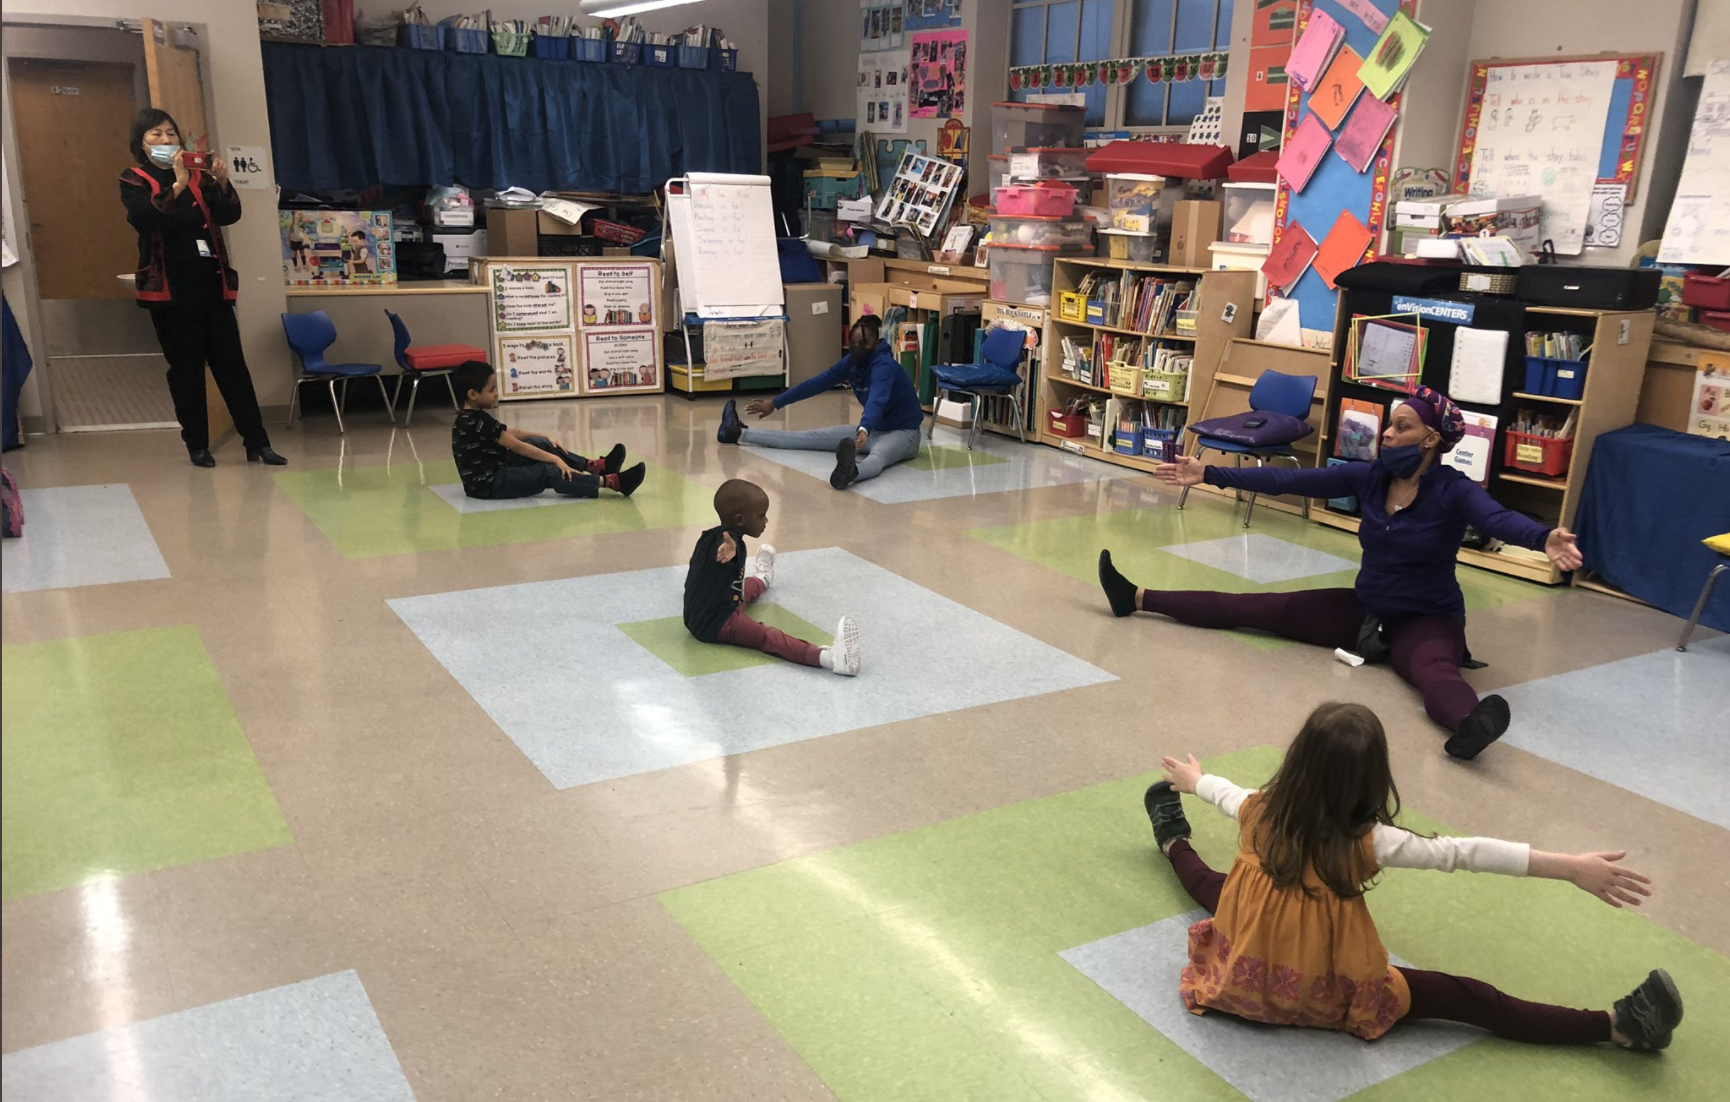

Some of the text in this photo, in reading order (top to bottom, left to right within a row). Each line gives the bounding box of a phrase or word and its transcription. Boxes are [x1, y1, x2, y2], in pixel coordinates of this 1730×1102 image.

[1248, 134, 1256, 142] 10
[1396, 303, 1468, 320] enVisionCENTERS
[1456, 448, 1474, 458] Center
[1454, 456, 1472, 465] Games
